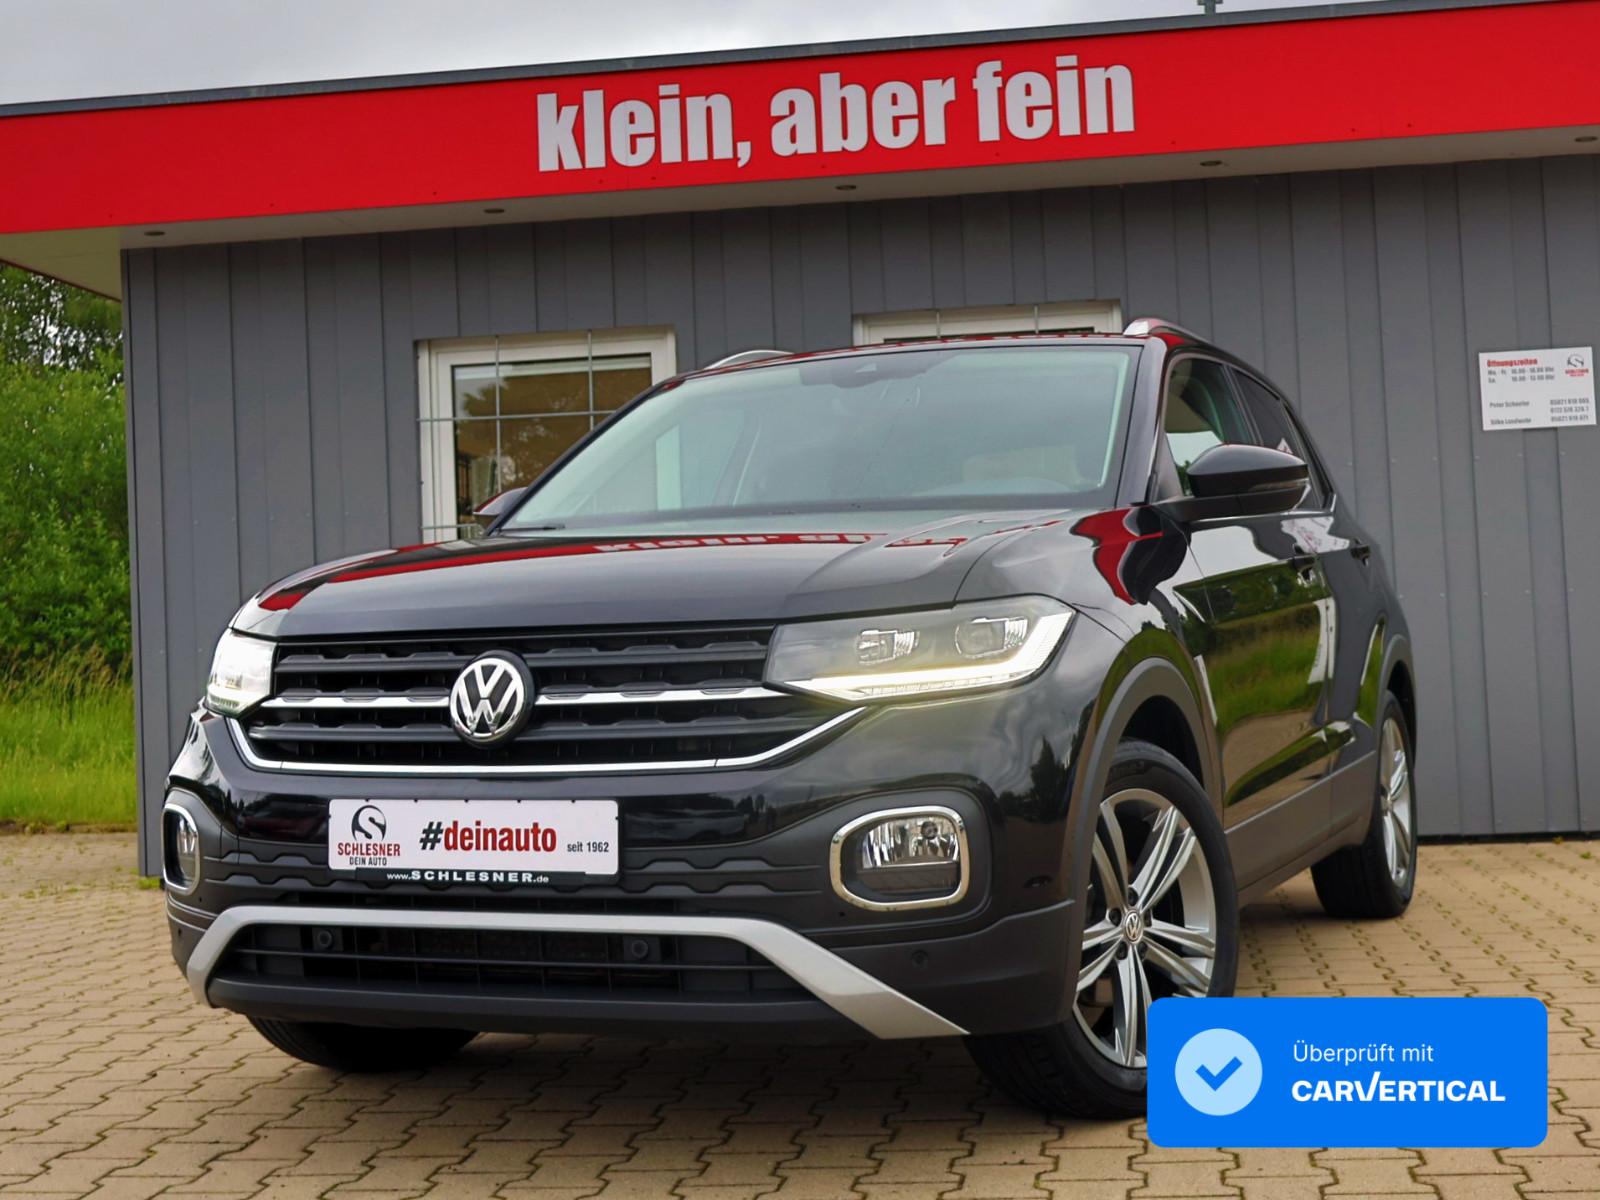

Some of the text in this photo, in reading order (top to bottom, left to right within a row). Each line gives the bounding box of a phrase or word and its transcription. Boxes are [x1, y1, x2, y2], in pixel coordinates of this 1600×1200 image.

[537, 54, 1135, 172] klein, aber fein
[419, 820, 557, 853] #deinauto
[337, 842, 401, 858] SCHLESNER
[566, 841, 610, 853] seit 1962
[349, 856, 387, 866] DEIN AUTO
[386, 870, 550, 884] www.SCHLESNER.de
